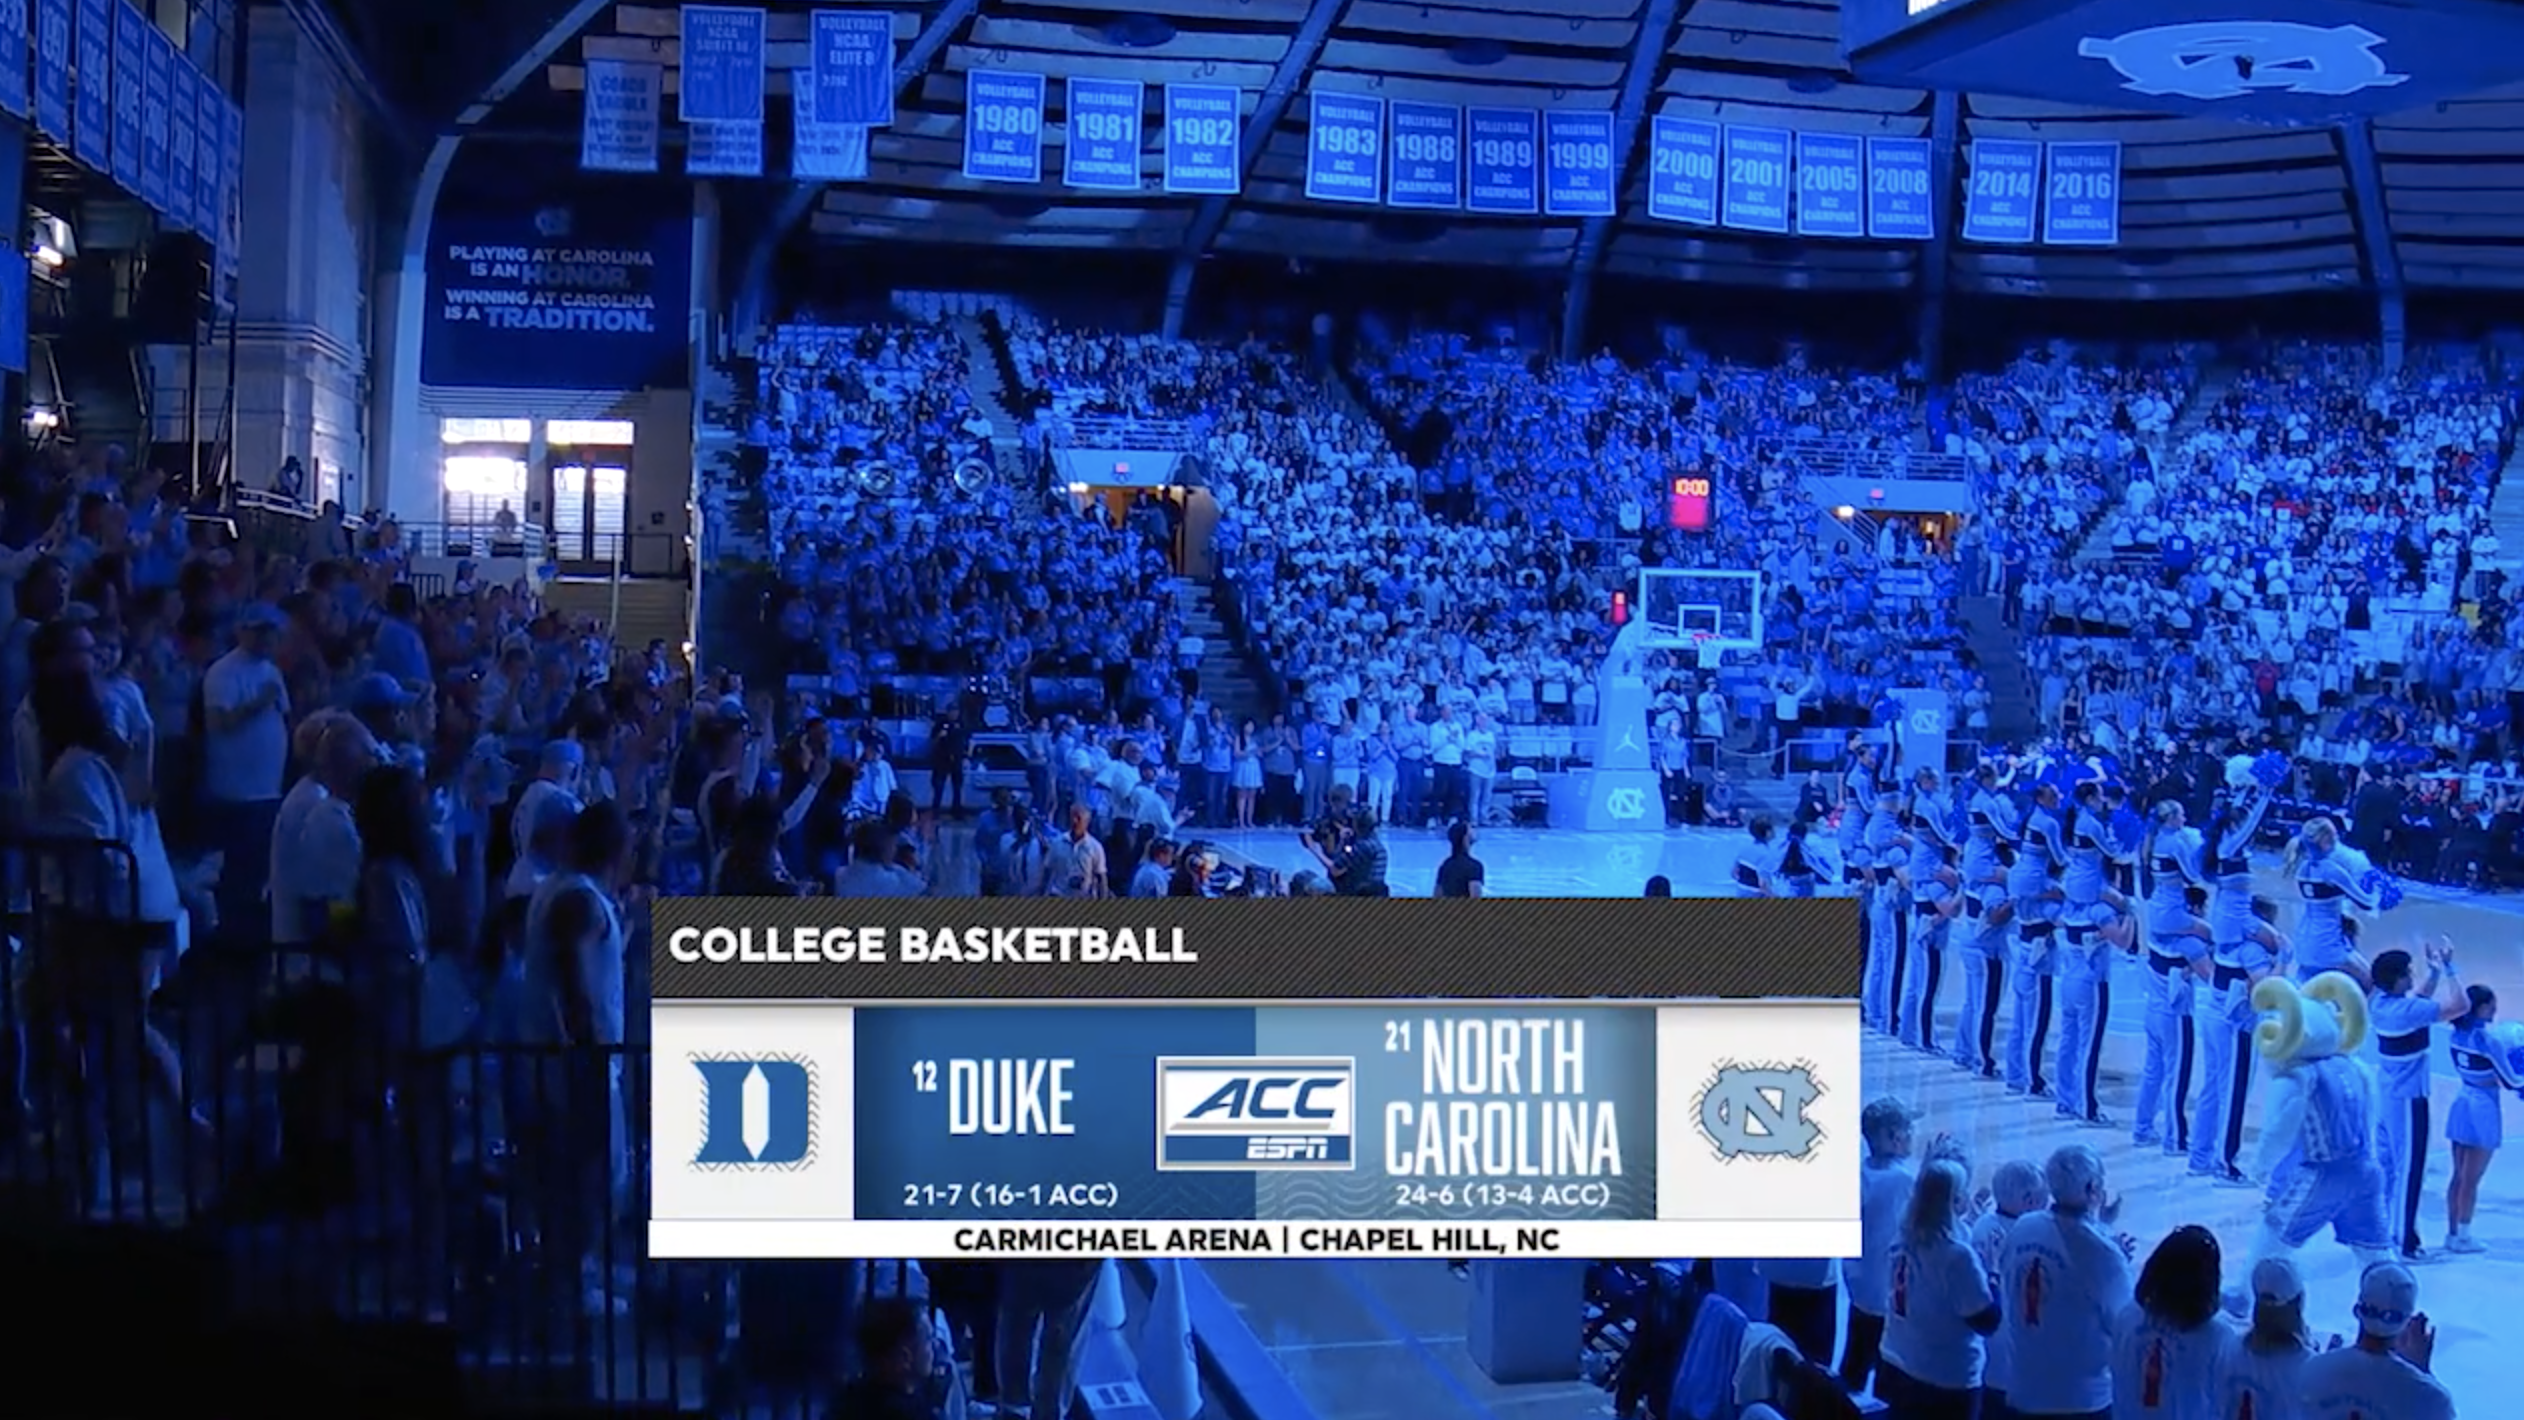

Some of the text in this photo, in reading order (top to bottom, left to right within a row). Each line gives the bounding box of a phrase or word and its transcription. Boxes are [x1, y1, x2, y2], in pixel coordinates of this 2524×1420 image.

[834, 33, 871, 48] NCAA
[829, 49, 863, 66] ELITE
[976, 83, 1036, 100] VOLLEYBALL
[1076, 92, 1135, 107] VOLLEYBALL
[1174, 98, 1232, 112] VOLLEYBALL
[974, 104, 1037, 135] 1980
[1319, 105, 1375, 123] VOLLEYBALL
[1398, 113, 1453, 129] VOLLEYBALL
[1074, 112, 1135, 142] 1981
[1172, 117, 1233, 146] 1982
[1474, 119, 1530, 135] VOLLEYBALL
[1552, 123, 1607, 137] VOLLEYBALL
[991, 139, 1015, 152] ACC
[1316, 125, 1377, 156] 1983
[1659, 129, 1712, 147] VOLLEYBALL
[1092, 147, 1114, 160] ACC
[1395, 133, 1455, 162] 1988
[1472, 139, 1533, 167] 1989
[1731, 138, 1784, 155] VOLLEYBALL
[1804, 145, 1855, 160] VOLLEYBALL
[972, 152, 1033, 169] CHAMPIONS
[1191, 152, 1214, 164] ACC
[1549, 141, 1610, 169] 1999
[1875, 150, 1926, 163] VOLLEYBALL
[1979, 153, 2033, 167] VOLLEYBALL
[2055, 155, 2111, 168] VOLLEYBALL
[1071, 161, 1133, 176] CHAMPIONS
[1334, 159, 1355, 173] ACC
[1656, 148, 1714, 180] 2000
[1172, 167, 1233, 180] CHAMPIONS
[1414, 167, 1436, 179] ACC
[1492, 172, 1513, 185] ACC
[1730, 157, 1784, 188] 2001
[1802, 164, 1858, 192] 2005
[1314, 172, 1373, 189] CHAMPIONS
[1395, 180, 1453, 195] CHAMPIONS
[1568, 174, 1591, 187] ACC
[1673, 181, 1694, 195] ACC
[1873, 167, 1929, 195] 2008
[1975, 169, 2031, 198] 2014
[2053, 172, 2113, 199] 2016
[1473, 186, 1531, 200] CHAMPIONS
[1551, 188, 1608, 202] CHAMPIONS
[1746, 190, 1766, 204] ACC
[1656, 193, 1710, 211] CHAMPIONS
[1820, 196, 1840, 209] ACC
[1891, 199, 1910, 212] ACC
[1990, 201, 2012, 214] ACC
[2071, 203, 2092, 216] ACC
[1730, 202, 1783, 219] CHAMPIONS
[1803, 210, 1856, 223] CHAMPIONS
[1875, 212, 1927, 226] CHAMPIONS
[1972, 214, 2027, 228] CHAMPIONS
[2052, 217, 2110, 230] CHAMPIONS
[449, 245, 654, 267] PLAYING AT CAROLINA
[470, 262, 631, 287] IS AN HONOR.
[445, 288, 655, 310] WINNING AT CAROLINA
[444, 305, 655, 332] IS A TRADITION.
[1675, 478, 1710, 497] 10:00
